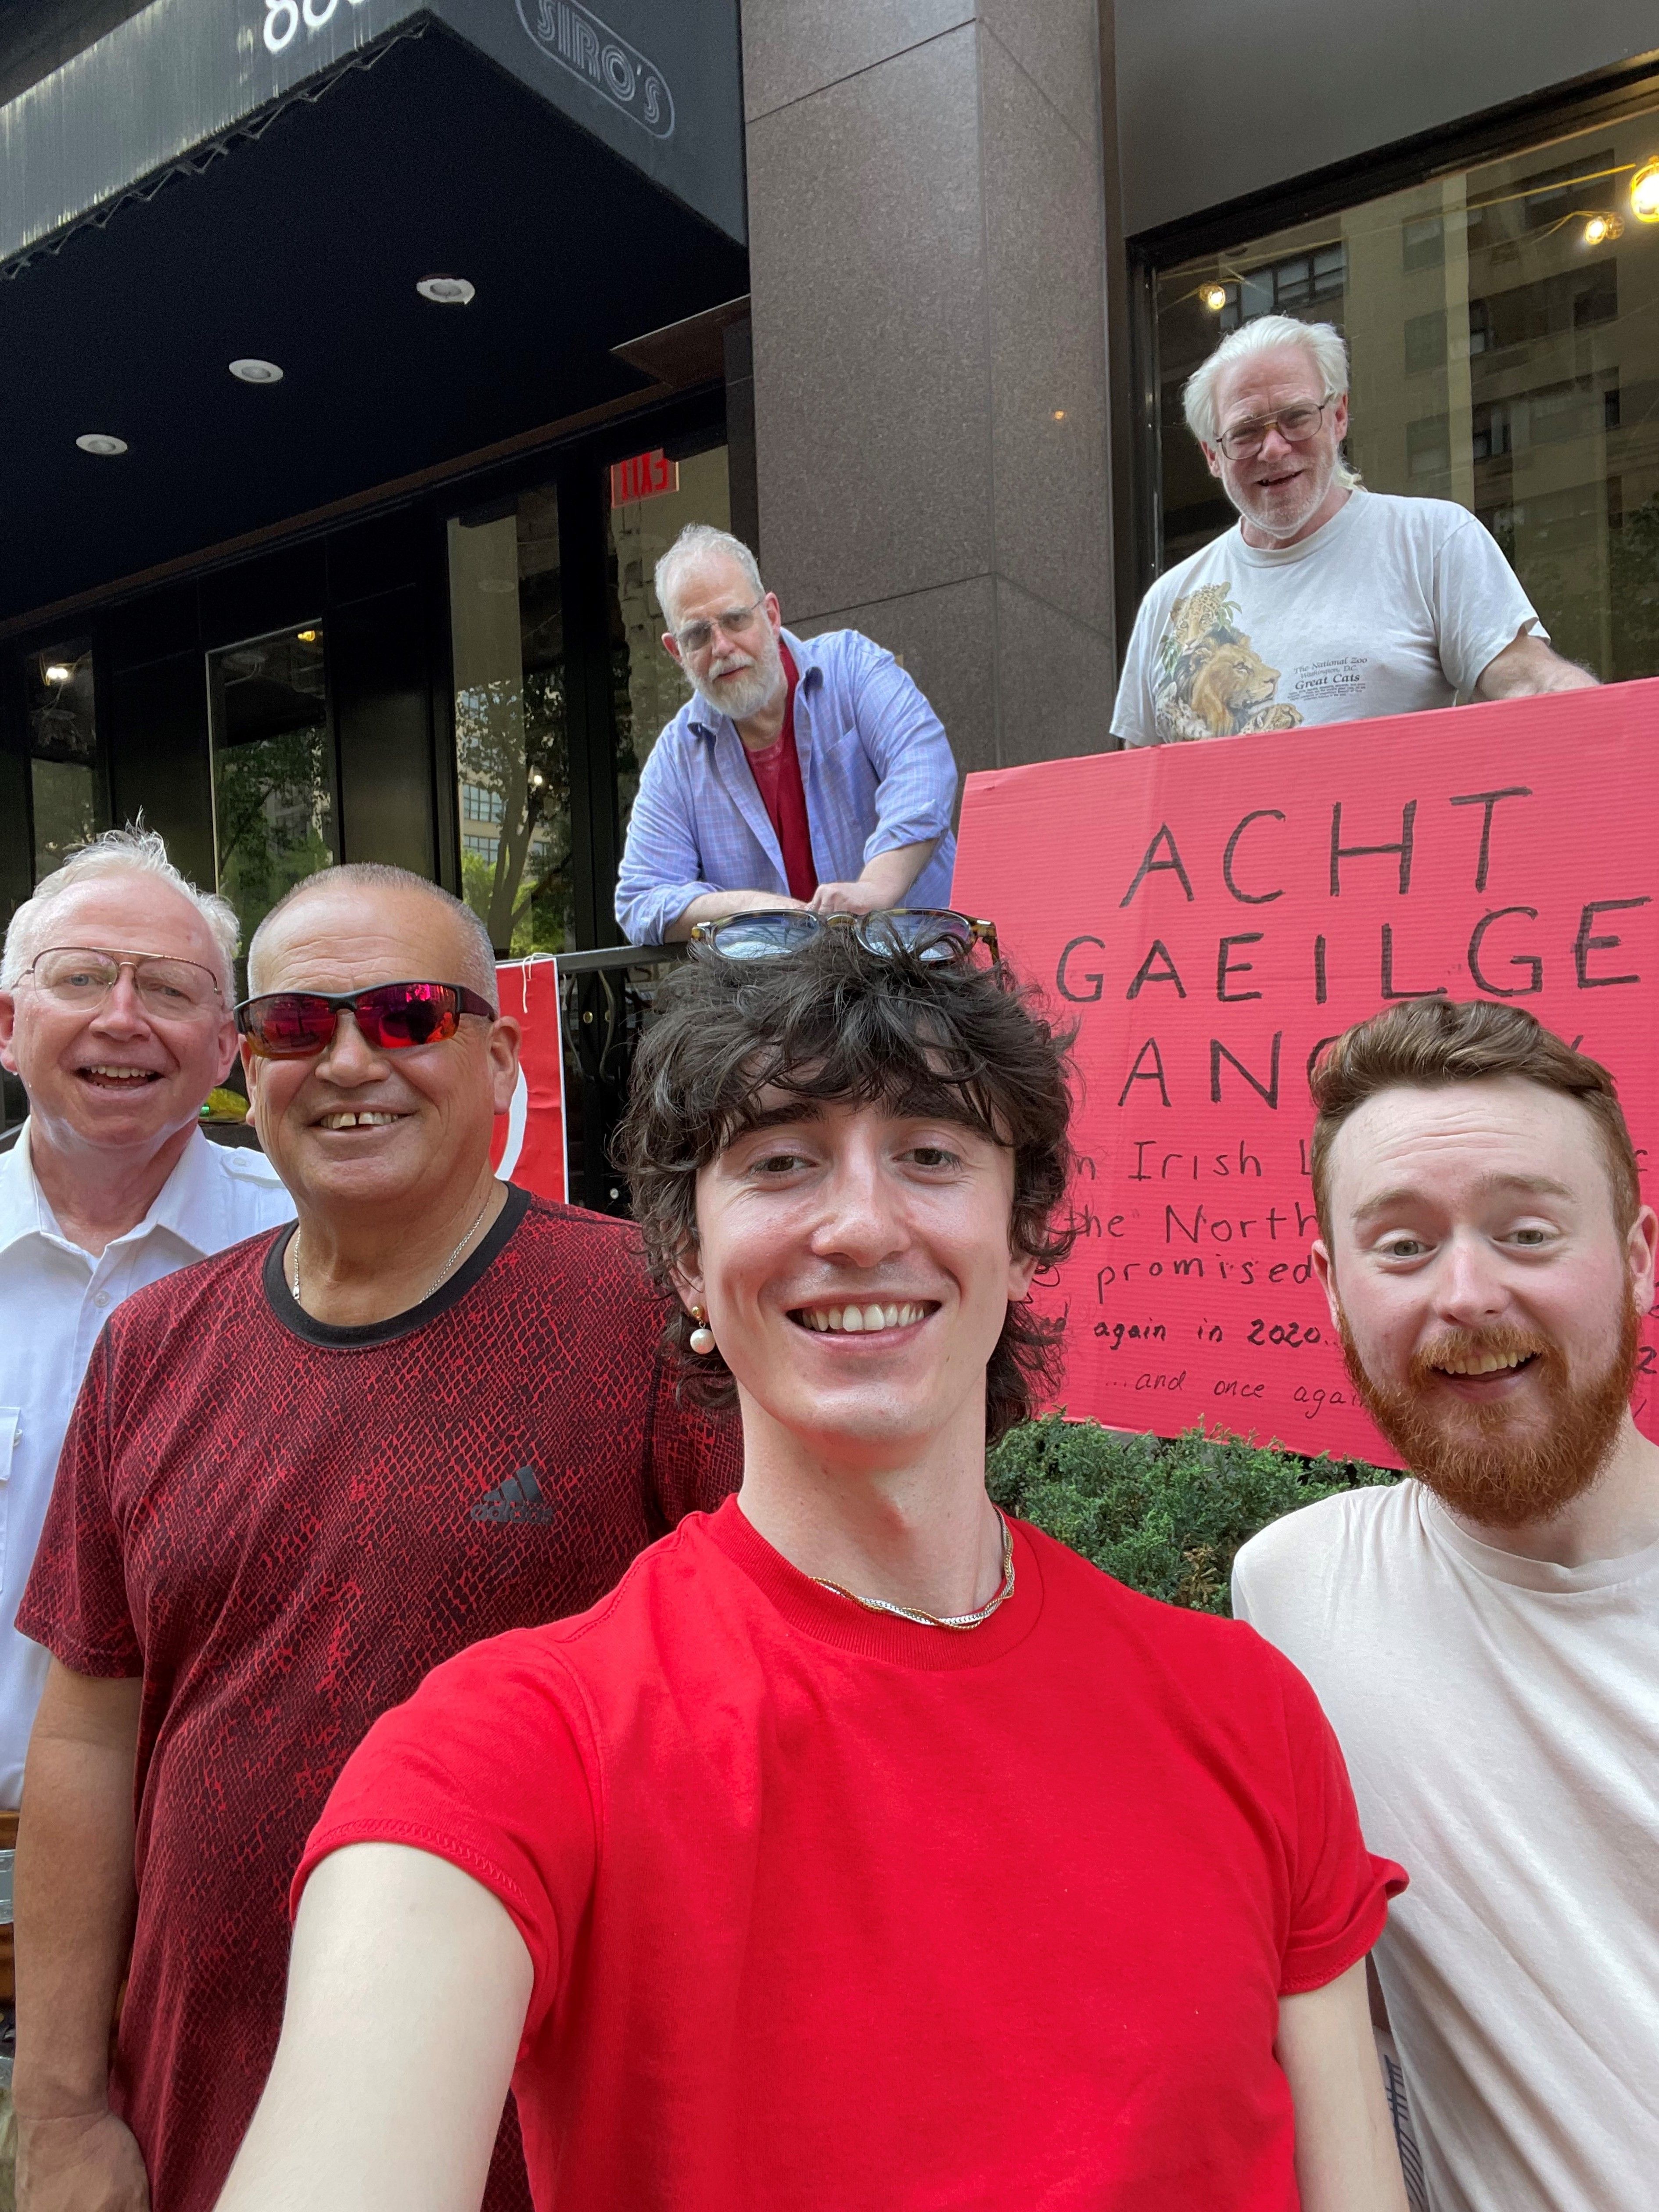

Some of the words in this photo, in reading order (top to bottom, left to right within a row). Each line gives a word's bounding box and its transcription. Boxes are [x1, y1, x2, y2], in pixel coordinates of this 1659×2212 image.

[537, 0, 659, 123] SIRO'S
[1294, 665, 1310, 675] The
[1312, 657, 1348, 669] National
[1295, 676, 1328, 690] Great
[1332, 673, 1360, 683] Cats
[1119, 786, 1534, 908] ACHT
[1056, 896, 1653, 1004] GAEILGE
[1128, 1140, 1262, 1181] Irish
[1097, 1253, 1312, 1304] promised
[1094, 1317, 1167, 1350] again
[1197, 1317, 1224, 1343] in
[1214, 1380, 1266, 1399] once
[1293, 1386, 1363, 1419] agai
